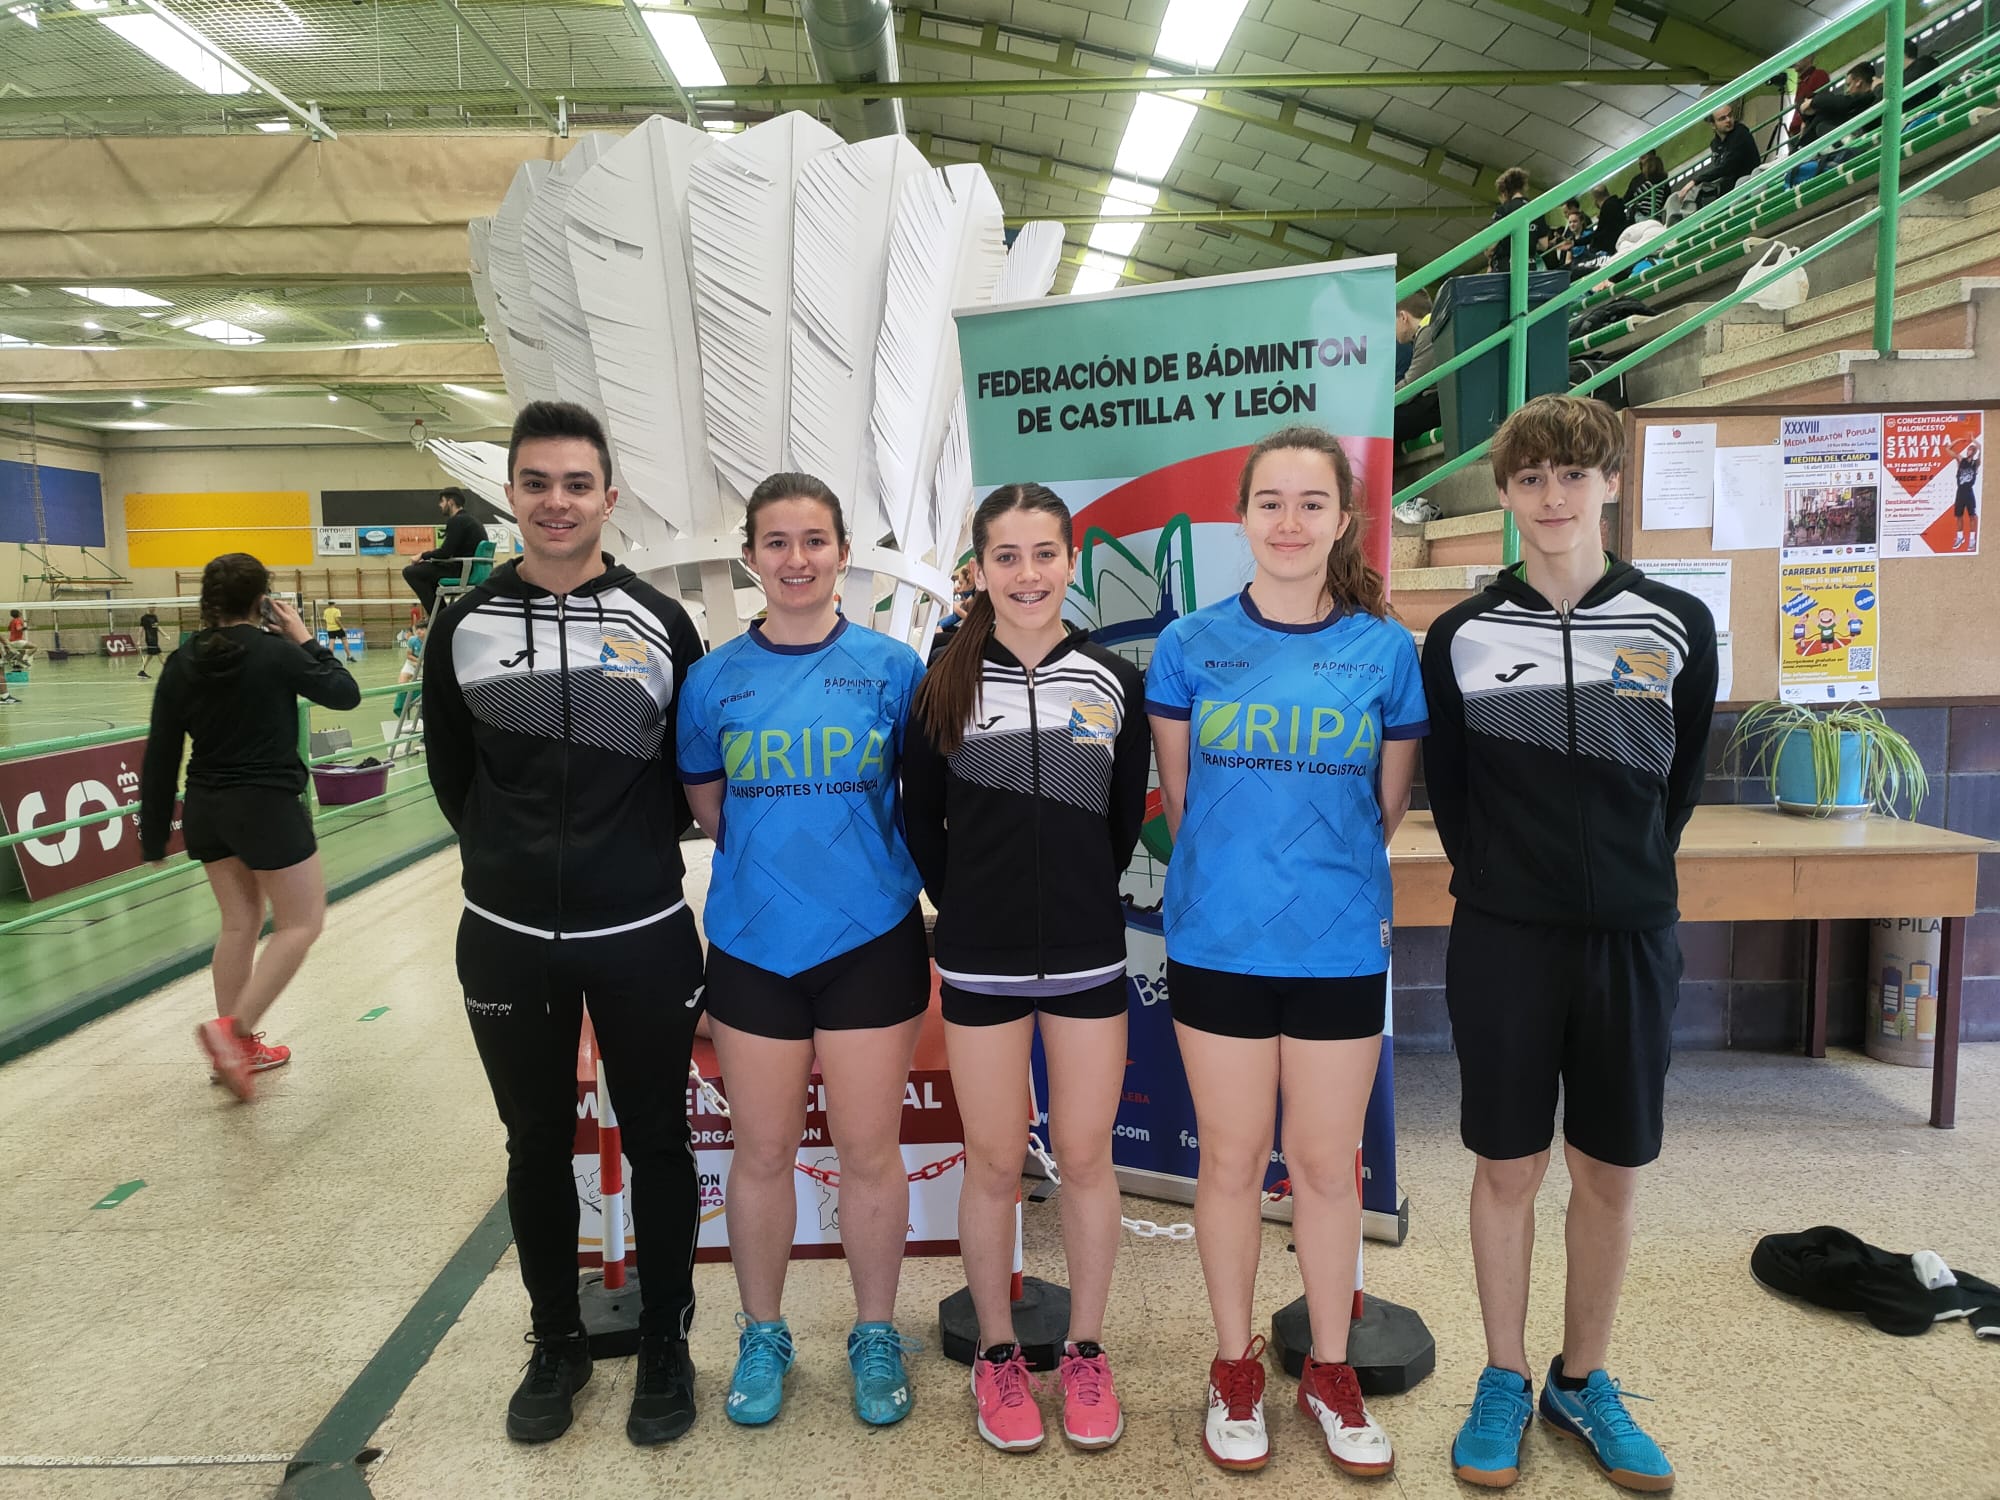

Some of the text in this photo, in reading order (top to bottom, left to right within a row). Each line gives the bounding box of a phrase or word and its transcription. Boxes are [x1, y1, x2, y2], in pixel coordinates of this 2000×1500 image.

[978, 335, 1368, 400] FEDERACIÓN DE BÁDMINTON
[1018, 380, 1316, 434] DE CASTILLA Y LEÓN
[1896, 415, 1959, 424] CONCENTRACIÓN
[1784, 421, 1819, 434] XXXVIII
[1897, 424, 1946, 432] BALONCESTO
[1887, 434, 1952, 447] SEMANA
[1790, 453, 1871, 464] MEDINA DEL CAMPO
[1886, 446, 1941, 458] SANTA
[1782, 565, 1875, 576] CARRERAS INFANTILES
[1245, 703, 1375, 760] RIPA
[760, 727, 885, 780] RIPA
[1201, 752, 1367, 777] TRANSPORTES Y LOGISTIC
[729, 779, 878, 798] TRANSPORTES Y LOGISTICA
